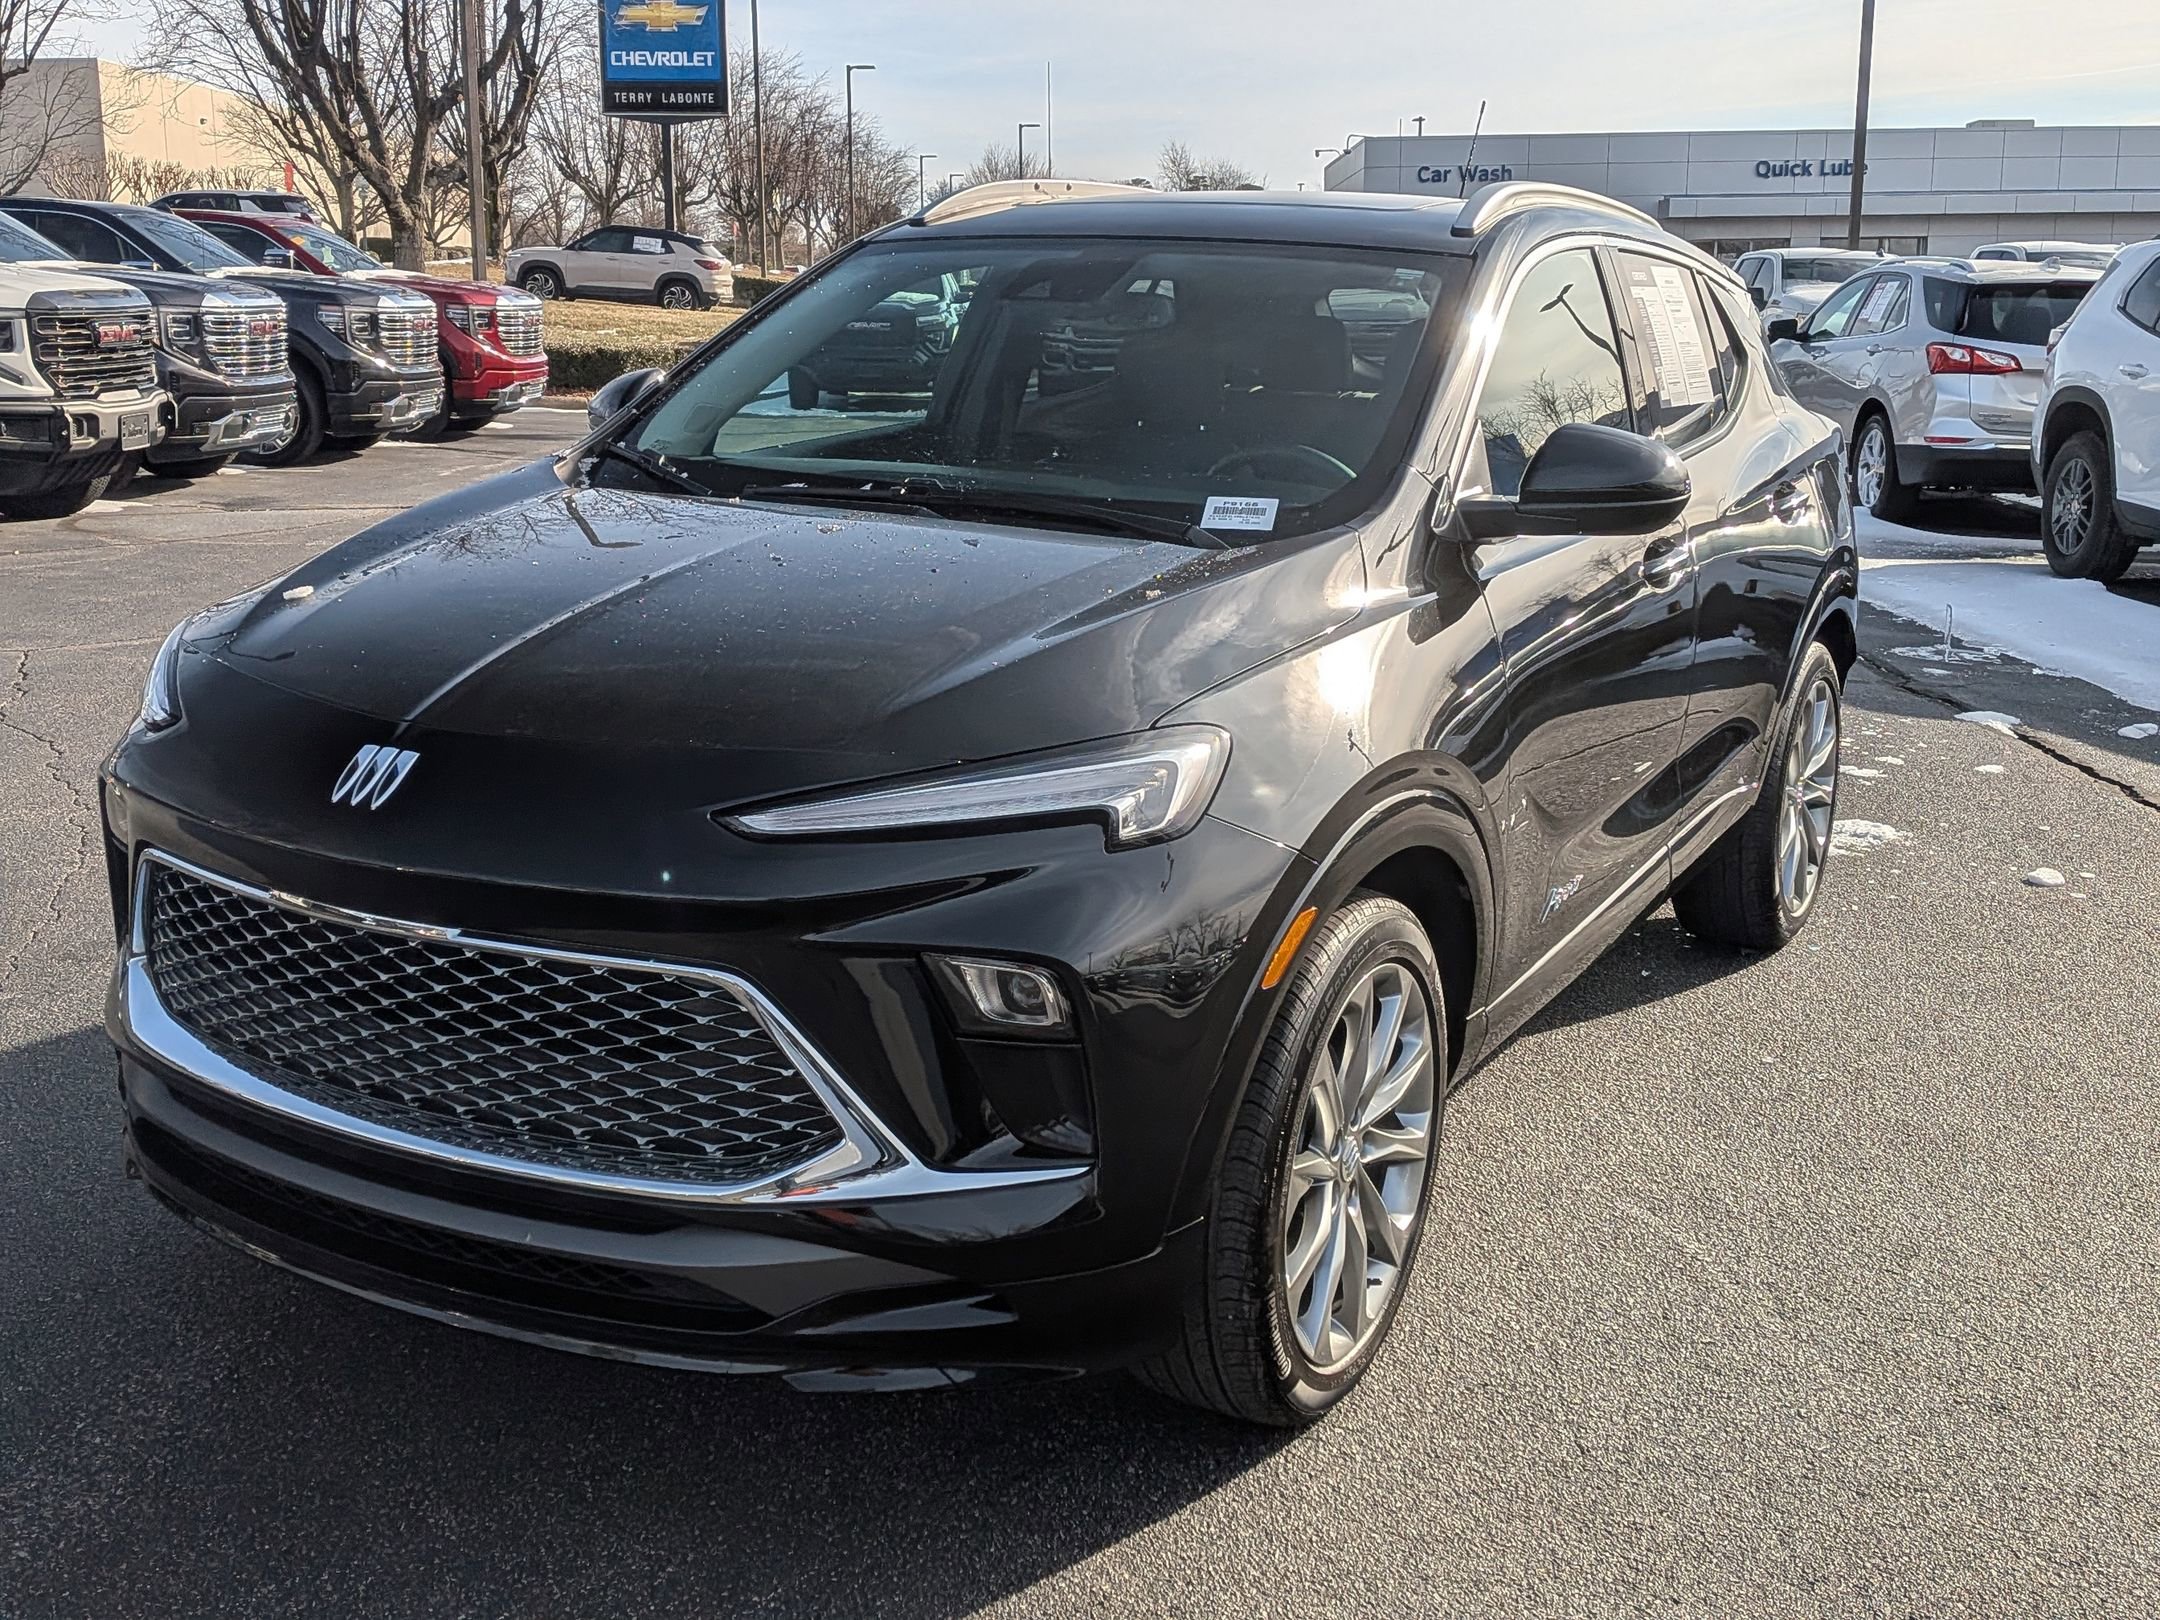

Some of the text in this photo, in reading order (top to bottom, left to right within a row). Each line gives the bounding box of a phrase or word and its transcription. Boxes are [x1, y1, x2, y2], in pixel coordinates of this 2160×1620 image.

[611, 51, 715, 67] CHEVROLET
[614, 92, 715, 104] TERRY LABONTE
[1417, 164, 1513, 183] Car Wash
[1756, 159, 1813, 179] Quick
